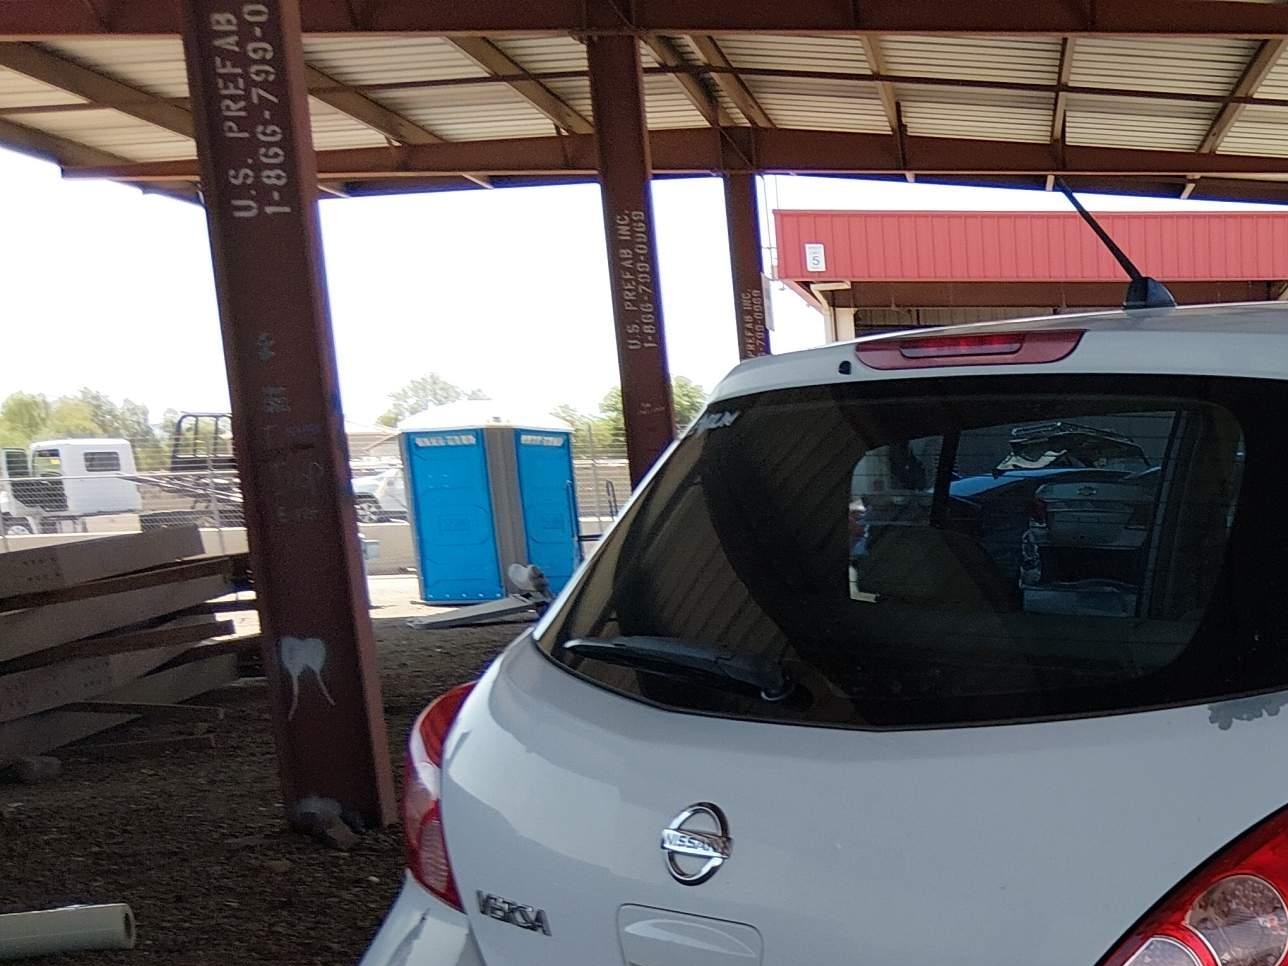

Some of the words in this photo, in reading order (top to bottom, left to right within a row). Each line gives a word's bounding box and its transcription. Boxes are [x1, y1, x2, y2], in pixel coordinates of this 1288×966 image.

[209, 12, 250, 138] PREFAB
[229, 158, 259, 217] U.S.
[620, 248, 639, 312] PREFAB
[812, 255, 820, 266] 5
[625, 319, 641, 350] U.S.
[476, 889, 552, 937] VERSA
